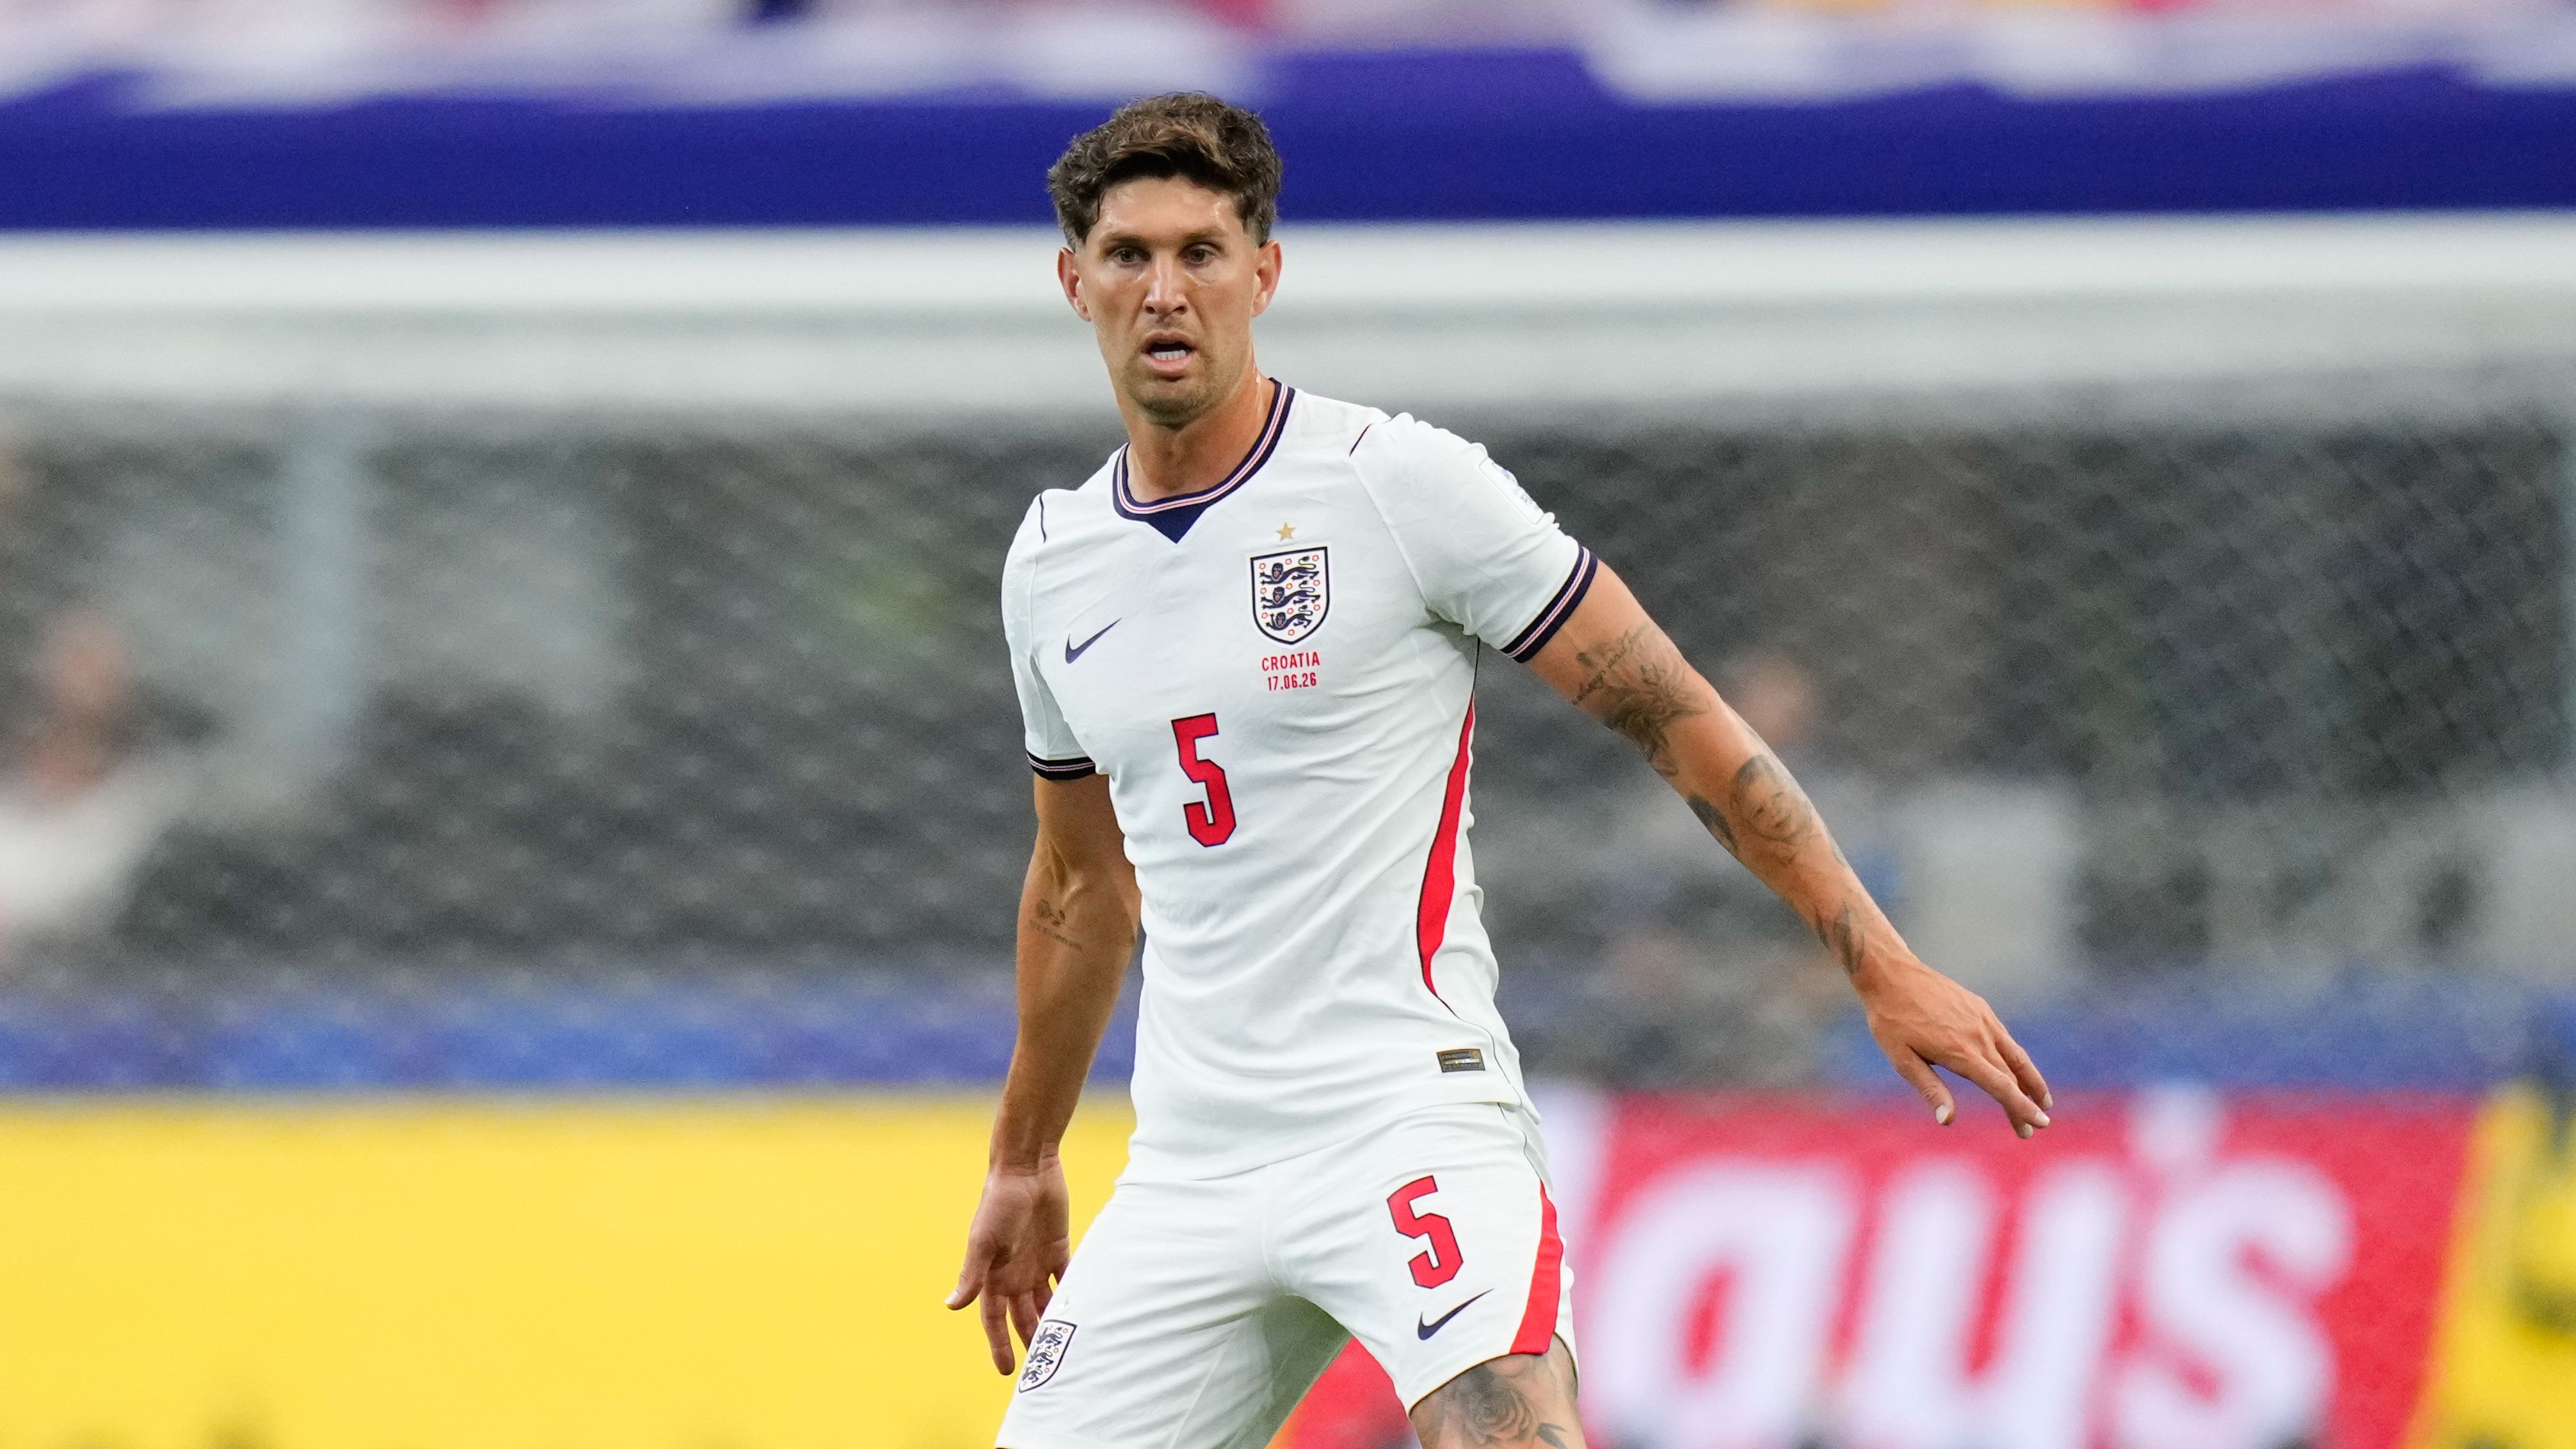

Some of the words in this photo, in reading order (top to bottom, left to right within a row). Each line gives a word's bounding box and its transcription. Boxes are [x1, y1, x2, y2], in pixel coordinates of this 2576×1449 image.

[1261, 652, 1320, 672] CROATIA
[1267, 672, 1316, 691] 17.06.26
[1171, 712, 1236, 847] 5
[1386, 1174, 1464, 1289] 5
